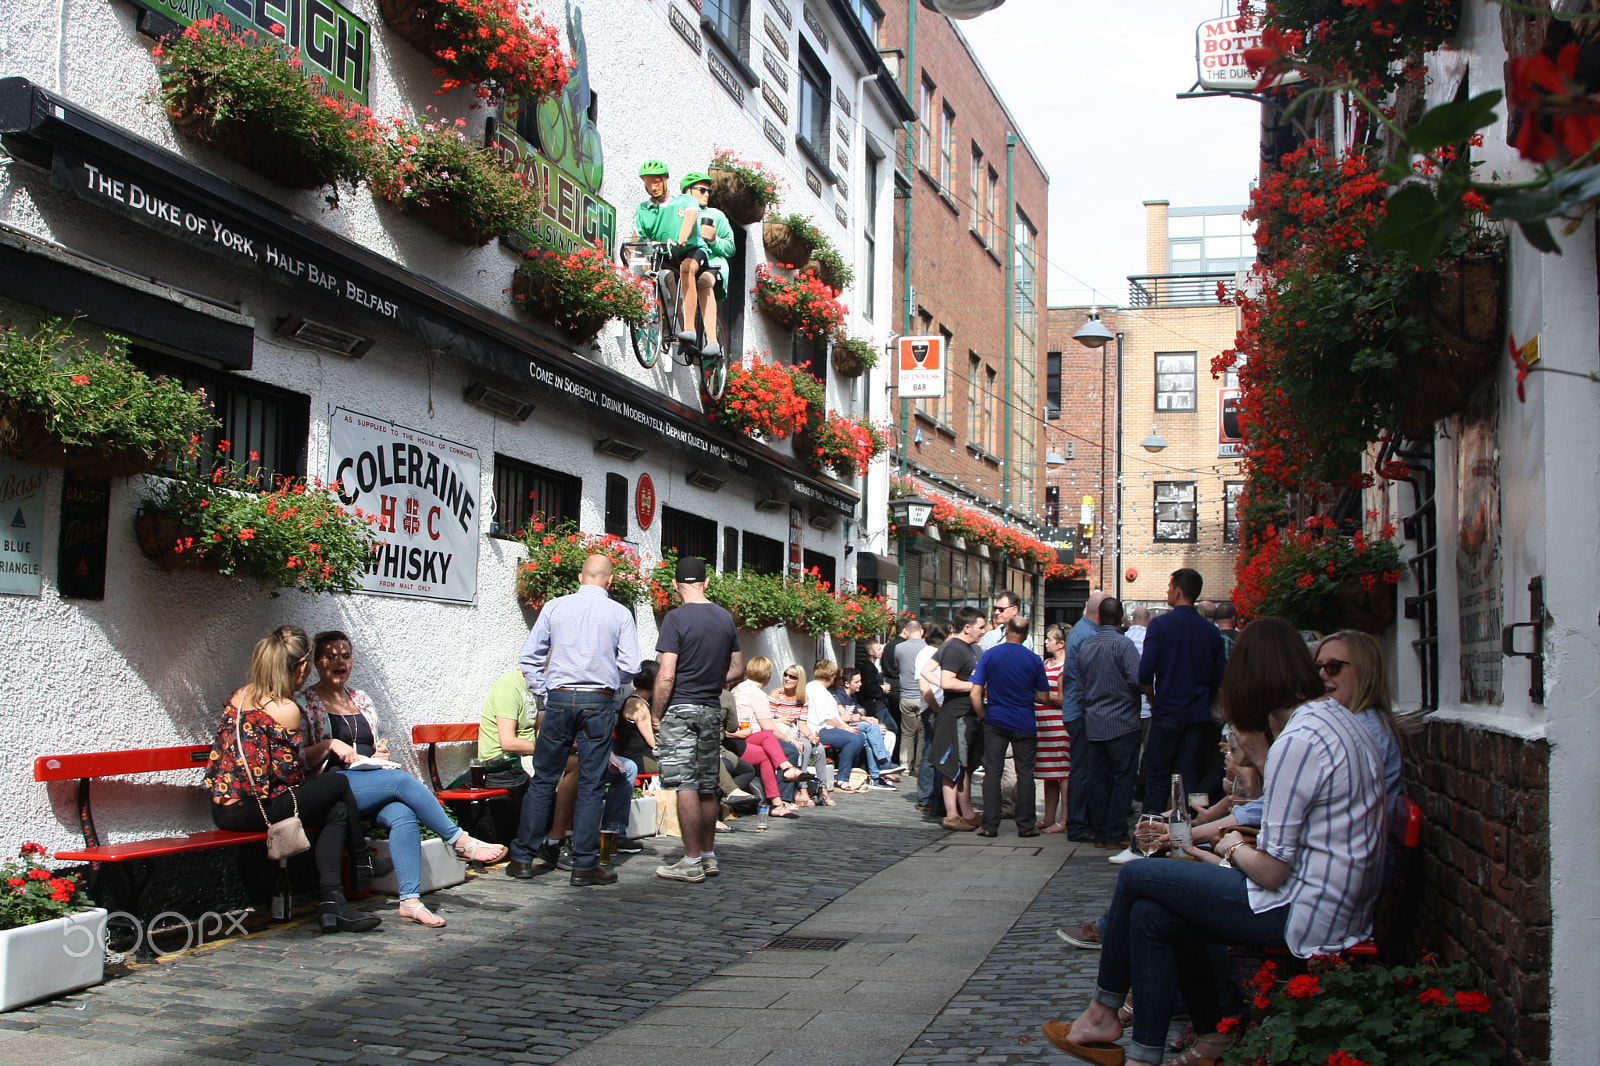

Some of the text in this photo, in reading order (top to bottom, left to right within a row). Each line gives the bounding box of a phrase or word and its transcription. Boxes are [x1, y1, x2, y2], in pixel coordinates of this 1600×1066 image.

[158, 0, 202, 23] CAR
[1203, 36, 1261, 52] BOTT
[1203, 53, 1246, 68] GUI
[1206, 68, 1252, 79] THE DUK
[497, 131, 614, 259] RALEIGH
[83, 161, 399, 319] THE DUKE OF YORK, HALF BAP, BELFAST
[901, 372, 939, 381] GUINNESS
[913, 383, 927, 391] BAR
[529, 361, 554, 386] COME
[554, 375, 564, 390] IN
[564, 377, 599, 406] SOBERLY,
[601, 393, 622, 414] DRINK
[622, 402, 664, 435] MODERATELY,
[665, 422, 688, 442] DEPART
[687, 432, 709, 452] QUIETLY
[344, 415, 473, 459] AS SUPPLIED TO THE HOUSE OF COMMONS
[0, 472, 44, 504] Bass
[336, 442, 475, 534] COLERAINE
[379, 495, 441, 541] H C
[4, 540, 31, 554] BLUE
[362, 540, 453, 585] WHISKY
[379, 580, 395, 588] FROM
